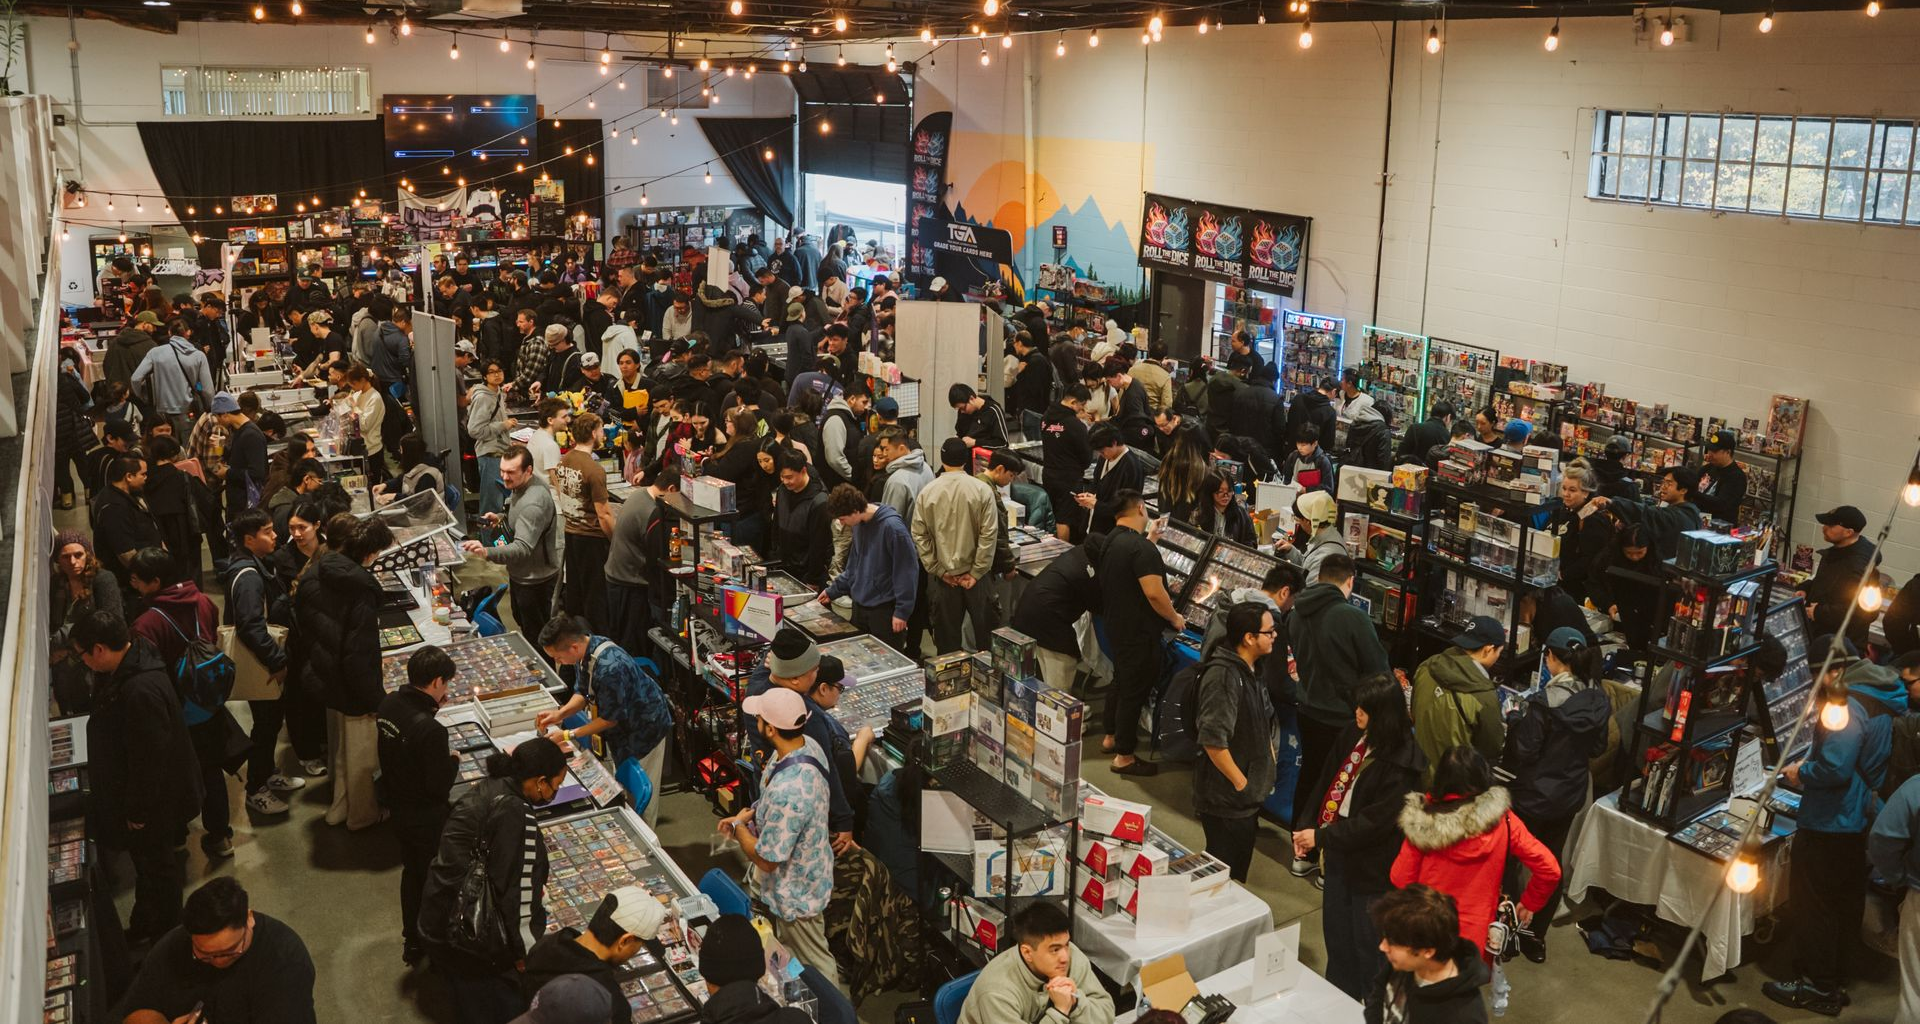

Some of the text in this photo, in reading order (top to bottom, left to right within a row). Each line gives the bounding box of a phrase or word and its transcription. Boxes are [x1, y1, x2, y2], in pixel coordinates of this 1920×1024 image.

[947, 223, 977, 244] TGA
[933, 241, 949, 250] GRADE
[949, 244, 962, 252] YOUR
[962, 247, 979, 256] CARDS
[979, 250, 992, 259] HERE
[1143, 245, 1163, 260] ROLL
[1162, 249, 1172, 258] THE
[1171, 251, 1190, 266] DICE
[1195, 255, 1215, 270] ROLL
[1214, 260, 1224, 268] THE
[1223, 261, 1243, 276] DICE
[1249, 265, 1269, 280] ROLL
[1269, 270, 1279, 279] THE
